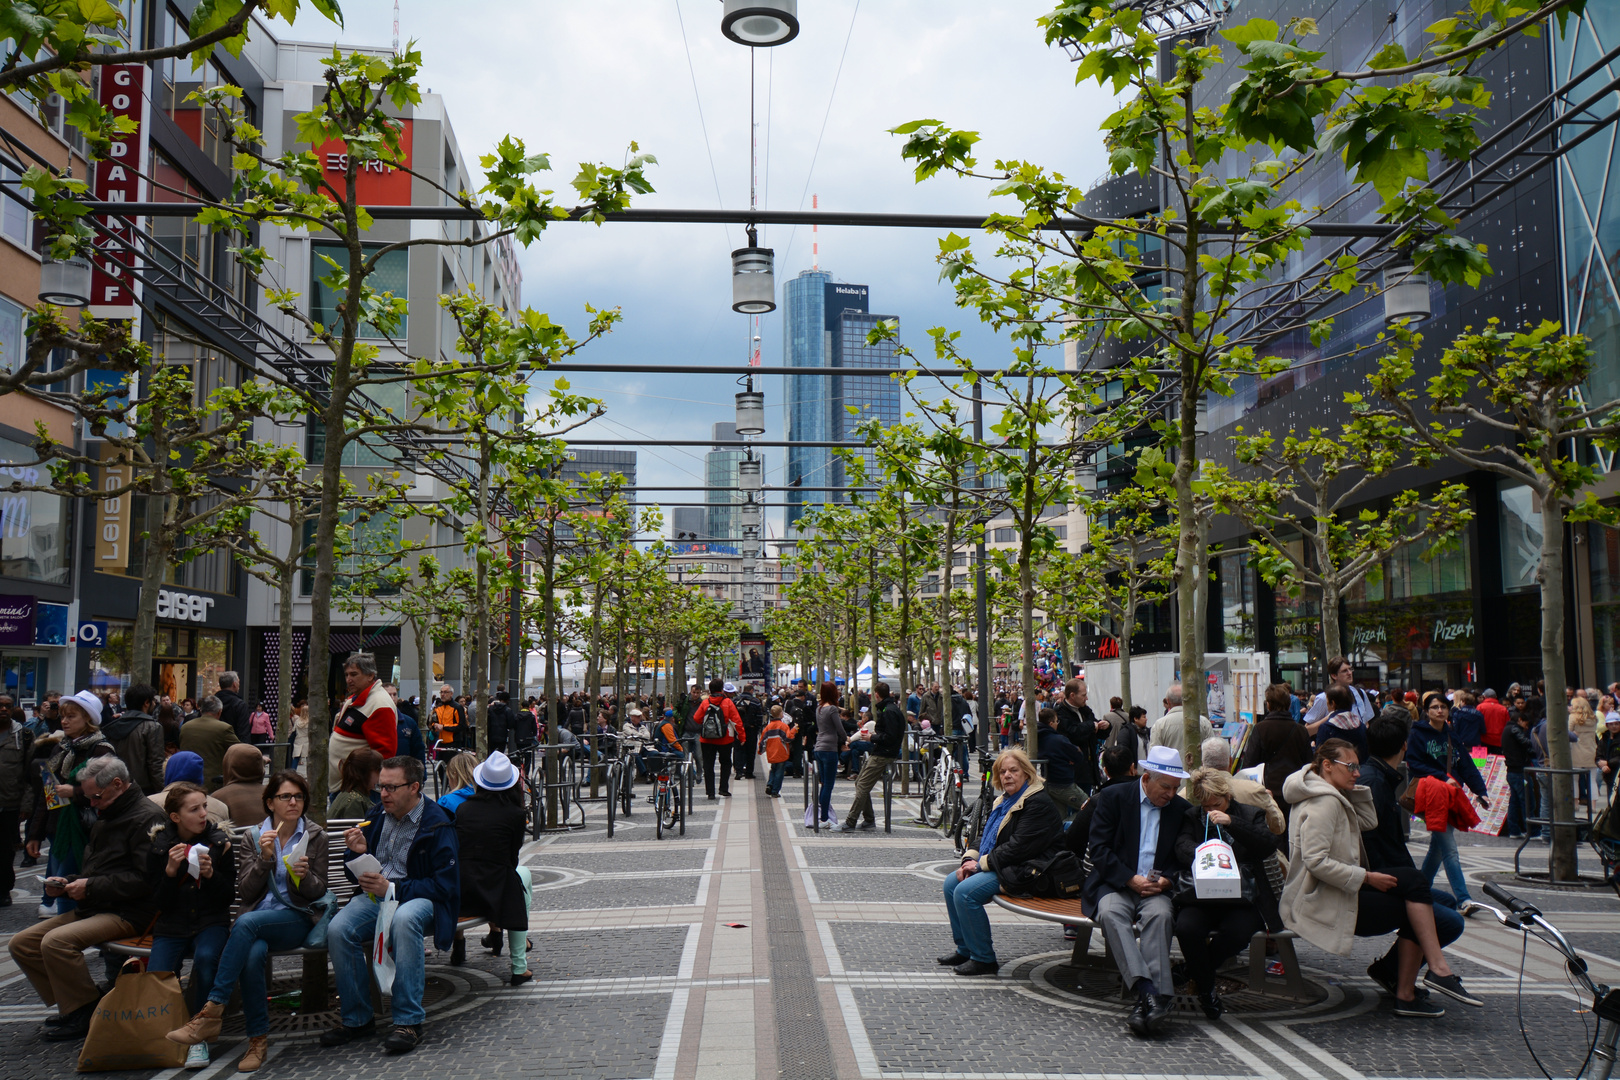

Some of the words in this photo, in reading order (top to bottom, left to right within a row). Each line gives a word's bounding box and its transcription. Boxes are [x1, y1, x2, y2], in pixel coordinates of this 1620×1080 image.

[105, 70, 131, 302] GODANKAUF
[139, 587, 215, 622] eiser
[1352, 626, 1376, 644] Pizza
[1433, 619, 1465, 643] Pizza
